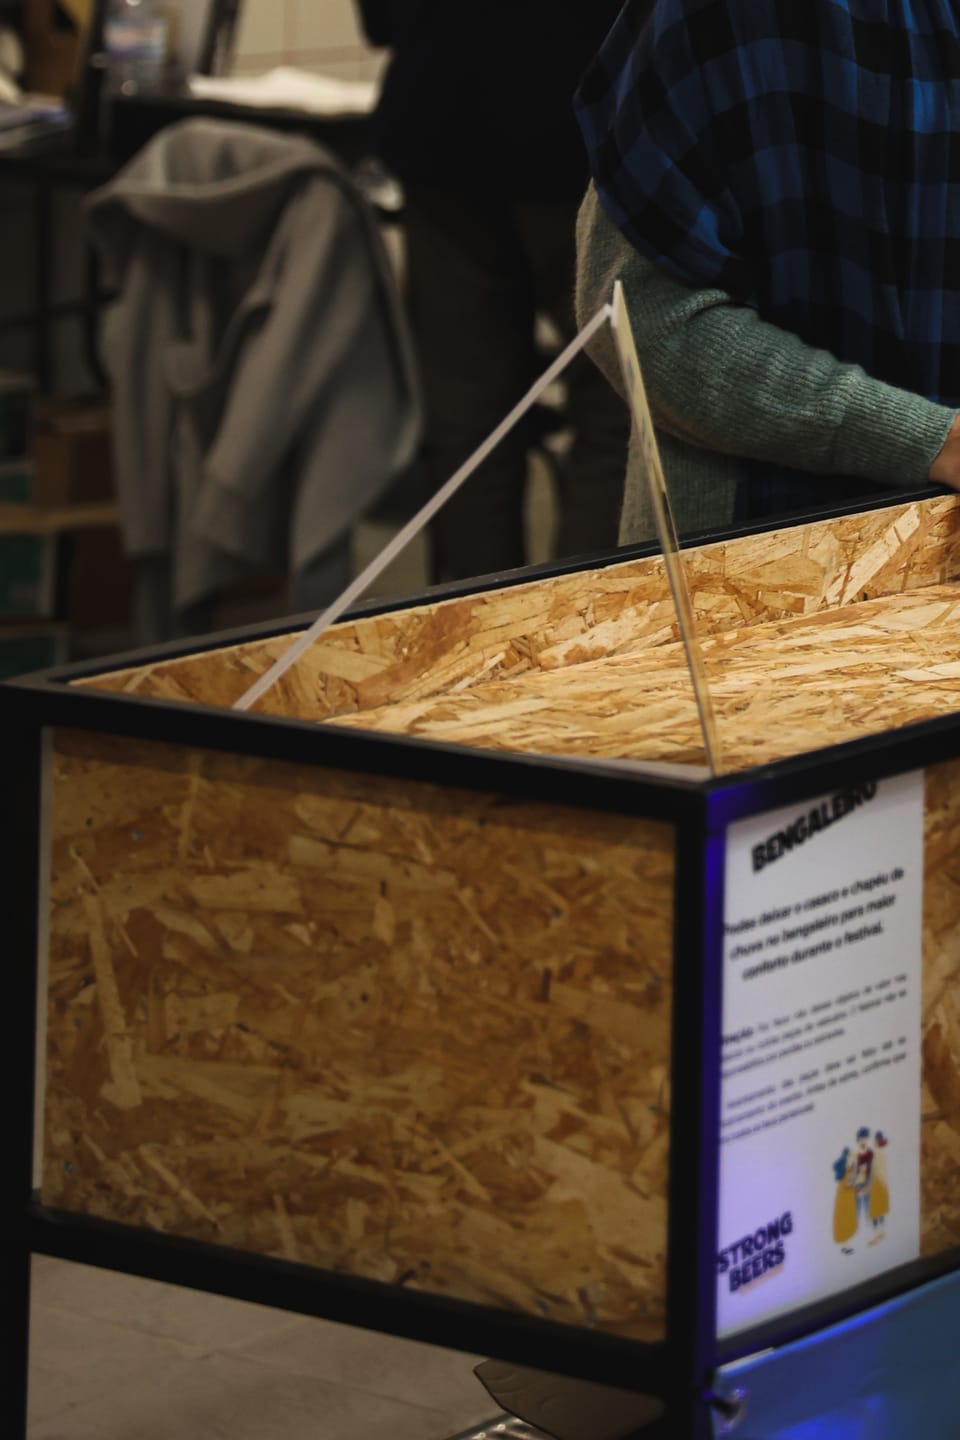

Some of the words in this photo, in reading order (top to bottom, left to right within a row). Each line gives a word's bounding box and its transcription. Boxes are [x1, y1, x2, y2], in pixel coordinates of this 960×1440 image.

[759, 906, 793, 926] deixar
[803, 889, 840, 912] casaco
[841, 886, 849, 898] e
[850, 872, 889, 895] chapéu
[891, 866, 905, 881] de
[730, 941, 763, 961] chuva
[765, 934, 781, 947] no
[782, 914, 839, 940] bengaleiro
[840, 905, 864, 926] para
[865, 894, 896, 912] maior
[742, 957, 790, 980] conforto
[791, 940, 833, 963] durante
[718, 1211, 793, 1273] STRONG
[729, 1241, 786, 1294] BEERS
